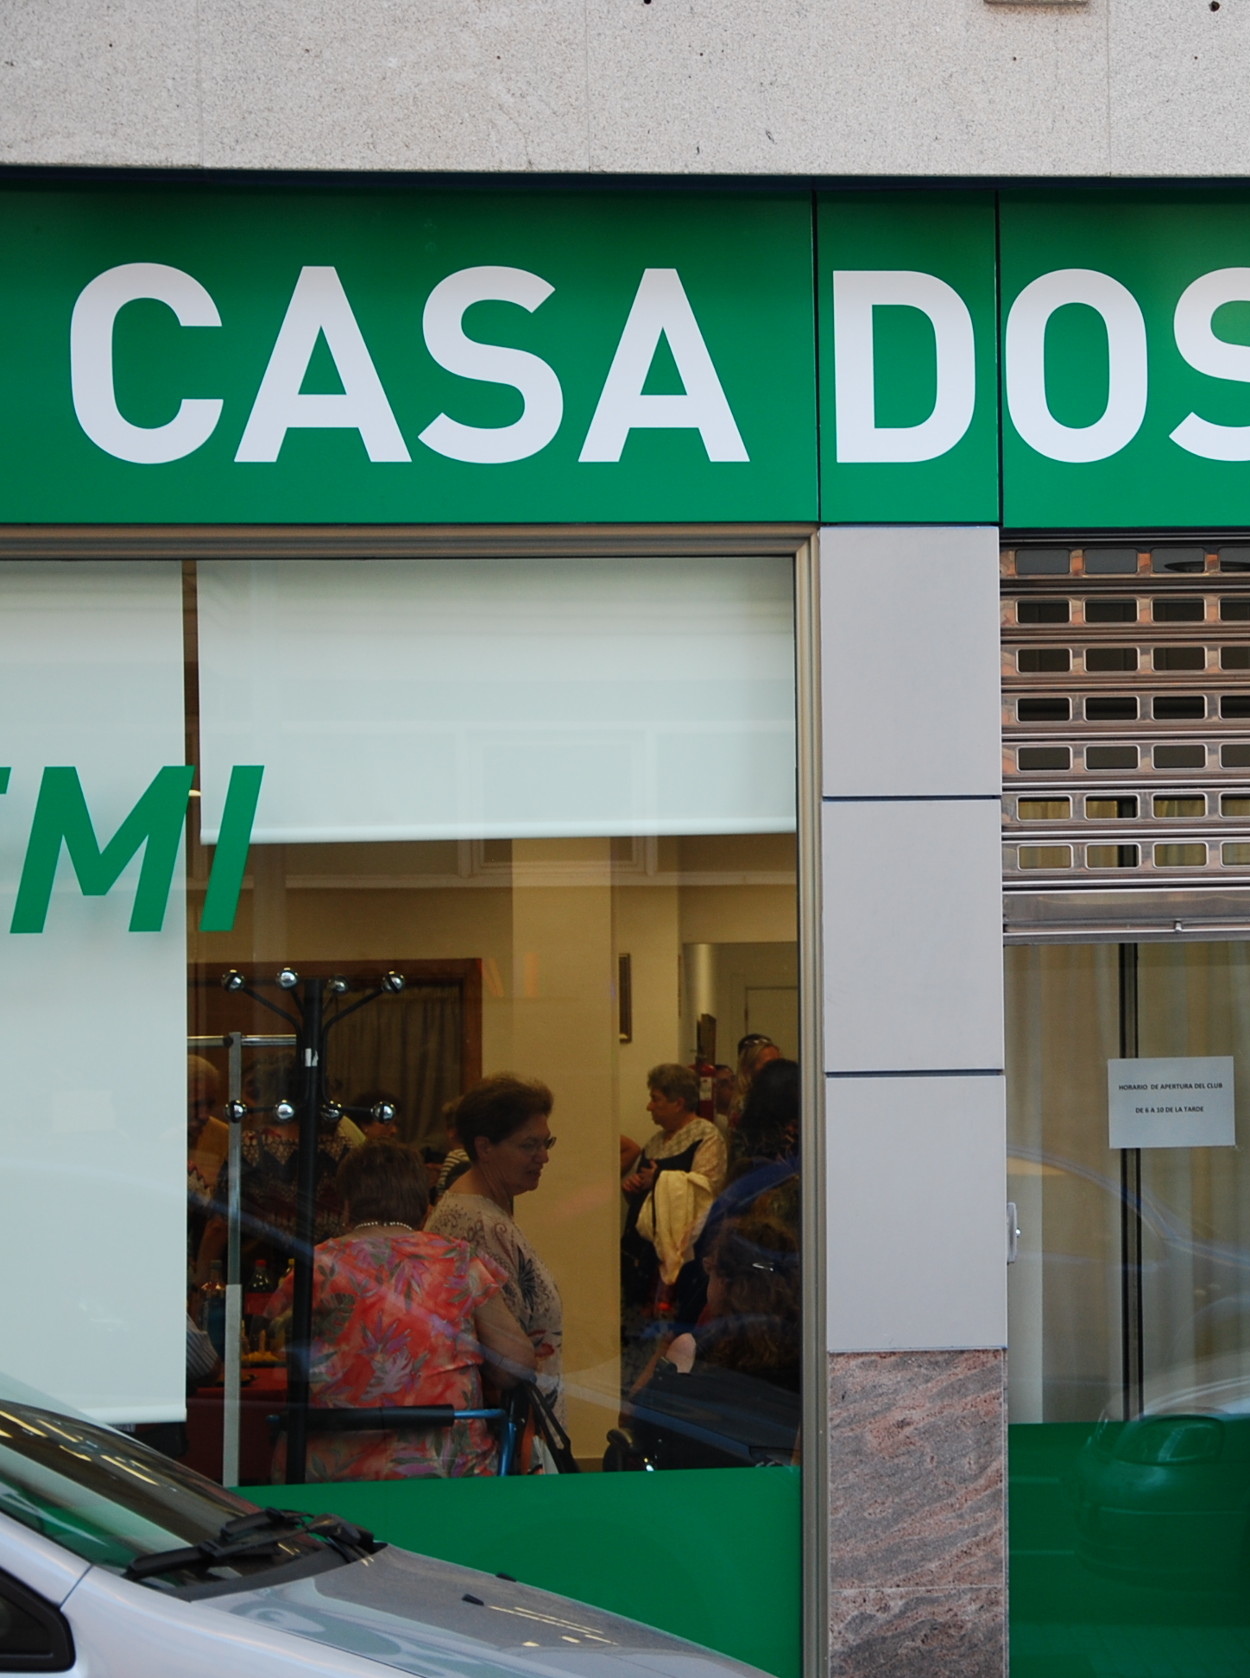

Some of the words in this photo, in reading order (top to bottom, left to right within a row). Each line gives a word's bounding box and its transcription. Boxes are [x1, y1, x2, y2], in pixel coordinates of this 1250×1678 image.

[71, 263, 749, 463] CASA
[0, 765, 266, 935] MI
[1194, 1082, 1205, 1090] DEL
